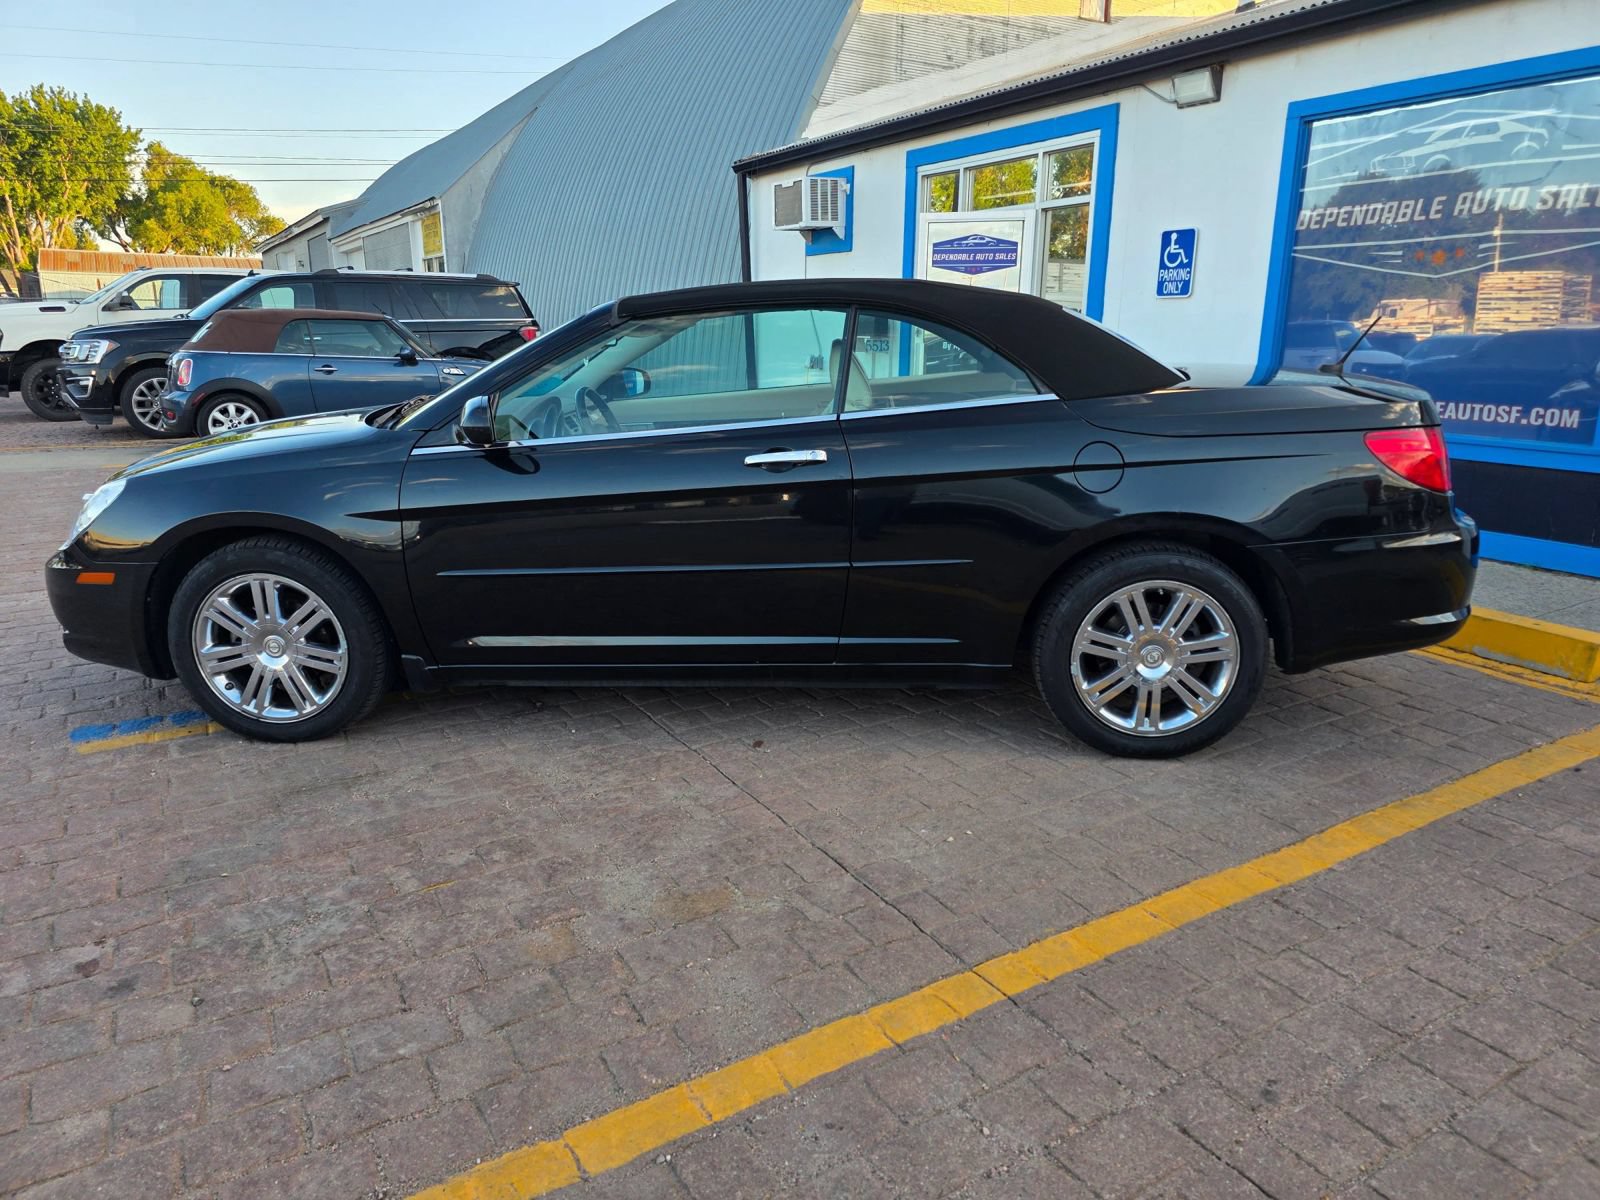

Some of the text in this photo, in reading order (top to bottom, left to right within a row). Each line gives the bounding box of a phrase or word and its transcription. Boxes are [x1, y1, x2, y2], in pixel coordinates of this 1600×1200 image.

[1296, 196, 1448, 230] DEPENDABLE
[1453, 186, 1530, 216] AUTO
[932, 252, 1017, 261] DEPENDABLE AUTO SALES
[1159, 268, 1190, 281] PARKING
[1163, 281, 1184, 294] ONLY
[865, 340, 889, 352] 5513
